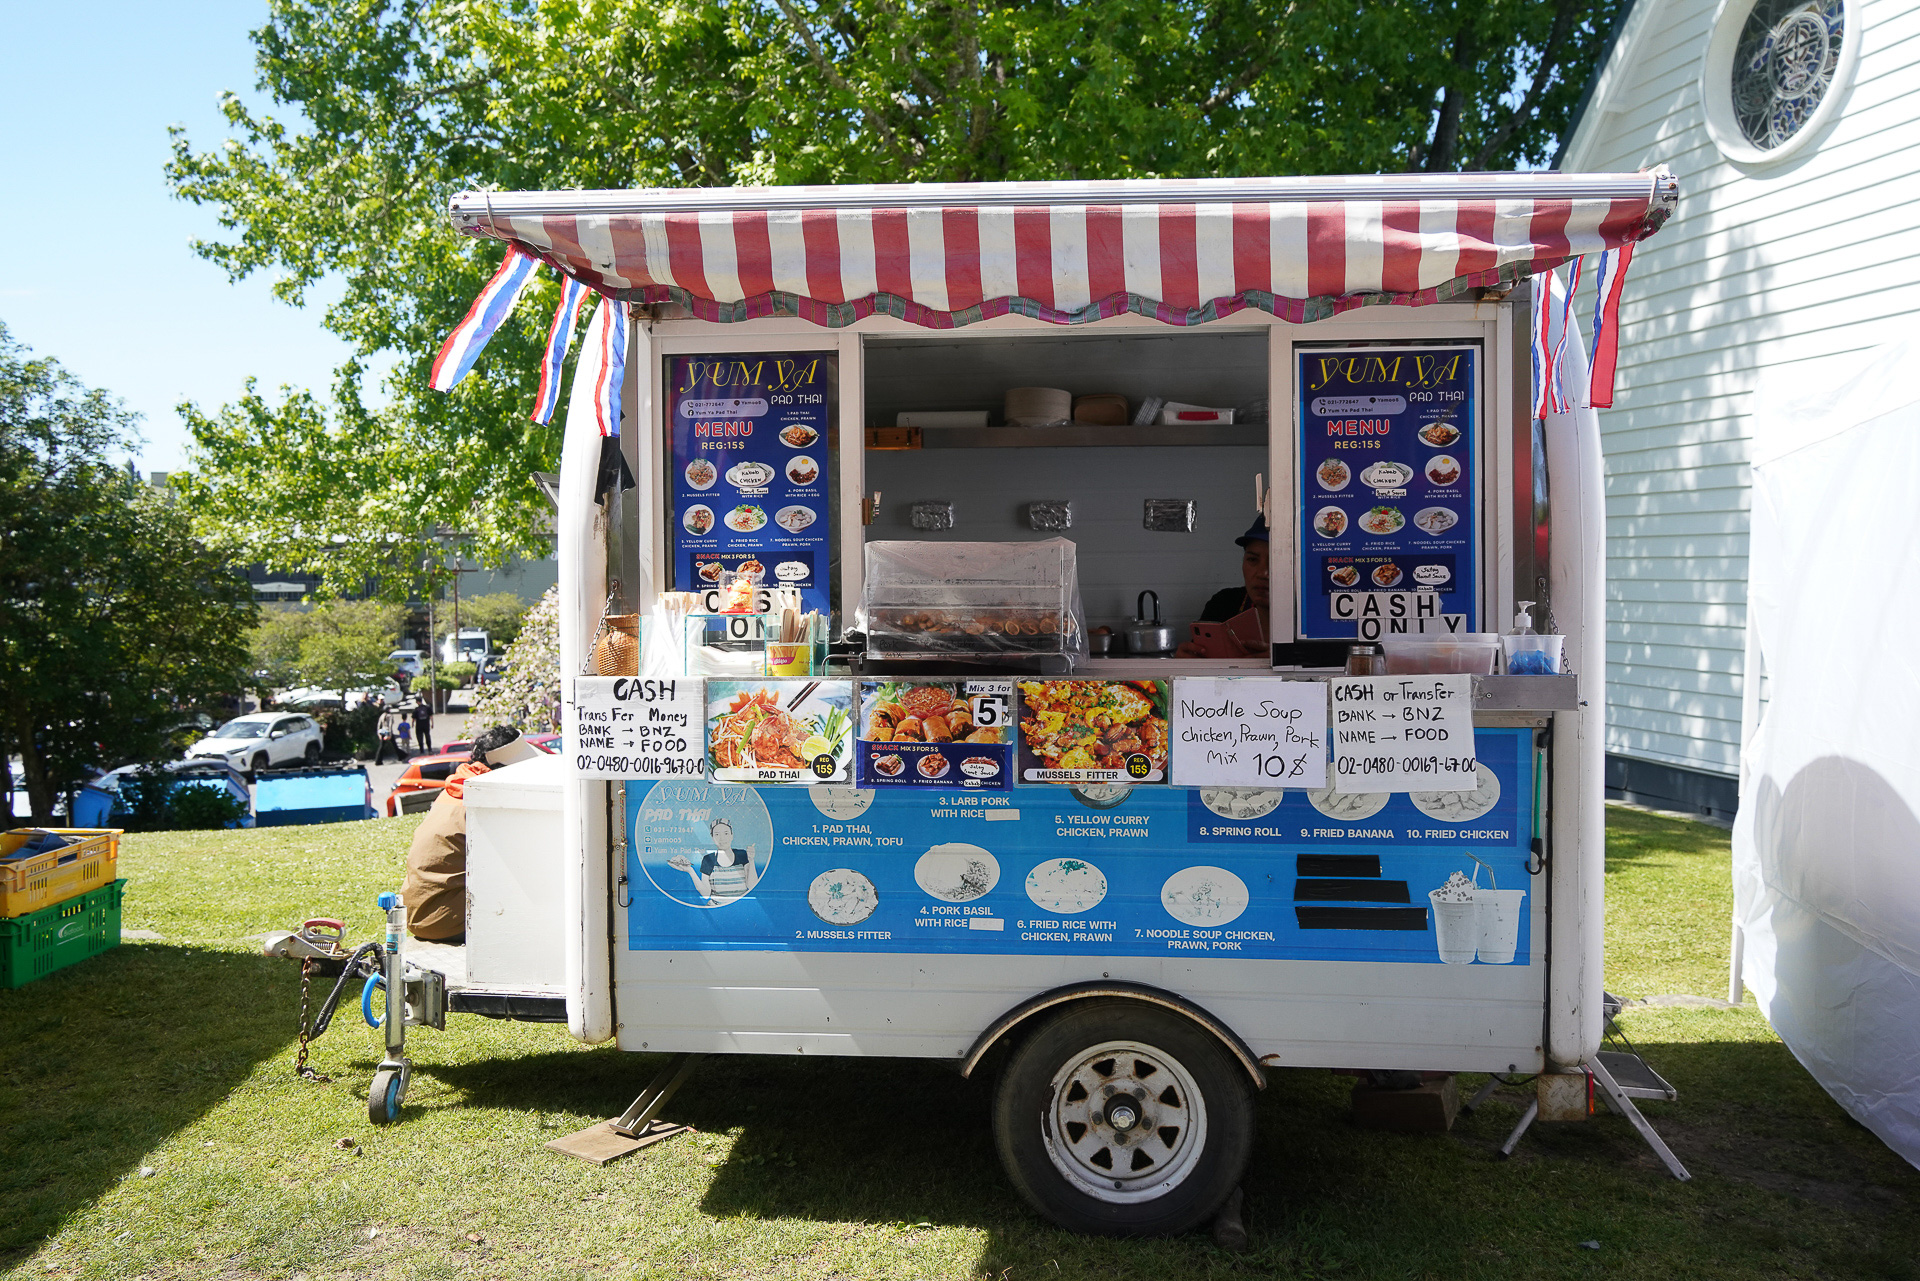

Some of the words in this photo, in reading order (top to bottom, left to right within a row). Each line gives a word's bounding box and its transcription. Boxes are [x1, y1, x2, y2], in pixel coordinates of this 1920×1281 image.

[680, 359, 766, 394] YUM
[768, 358, 820, 393] YA
[1310, 356, 1404, 390] YUM
[1406, 354, 1462, 390] YA
[771, 394, 793, 405] PAD
[798, 394, 822, 404] THAI
[1409, 391, 1433, 402] PAD
[1438, 390, 1464, 401] THAI
[695, 421, 753, 438] MENU
[1327, 419, 1390, 436] MENU
[702, 441, 745, 450] REG:15$
[1334, 440, 1381, 449] REG:15$
[1335, 594, 1434, 618] CASH
[614, 678, 676, 702] CASH
[1335, 683, 1374, 701] CASH
[1383, 691, 1398, 701] or
[978, 698, 997, 725] 5
[1181, 700, 1244, 718] Noodle
[1254, 700, 1302, 724] Soup
[1338, 709, 1376, 723] BANK
[1402, 707, 1444, 722] BNZ
[649, 708, 687, 727] Money
[579, 724, 611, 737] BANK
[640, 726, 676, 737] BNZ
[1339, 731, 1376, 744] NAME
[1405, 728, 1449, 742] FOOD
[1240, 724, 1278, 751] Prawn,
[1286, 726, 1319, 748] Pork
[580, 737, 615, 749] NAME
[641, 738, 687, 752] FOOD
[1207, 750, 1237, 765] Mix
[758, 770, 776, 779] PAD
[778, 770, 800, 779] THAI
[816, 763, 833, 776] 15$
[1037, 770, 1081, 780] MUSSELS
[1086, 770, 1118, 780] FITTER
[1130, 764, 1148, 775] 15$
[656, 787, 709, 804] YUM
[716, 786, 748, 806] YA
[939, 797, 948, 806] 3.
[951, 797, 978, 806] LARB
[980, 797, 1010, 806] PORK
[644, 808, 673, 822] PAD
[678, 808, 712, 822] THAI
[931, 809, 958, 818] WITH
[960, 809, 984, 818] RICE
[1055, 815, 1065, 824] 5.
[1067, 815, 1111, 824] YELLOW
[1113, 816, 1150, 825] CURRY
[812, 825, 820, 834] 1.
[823, 825, 843, 834] PAD
[845, 825, 872, 835] THAI,
[1056, 828, 1106, 838] CHICKEN,
[1109, 828, 1148, 838] PRAWN
[1199, 827, 1210, 836] 8.
[1212, 827, 1251, 836] SPRING
[1254, 828, 1282, 837] ROLL
[1300, 829, 1310, 838] 9.
[1313, 829, 1345, 838] FRIED
[1348, 829, 1394, 838] BANANA
[1407, 829, 1422, 838] 10.
[1425, 830, 1457, 839] FRIED
[1460, 830, 1509, 839] CHICKEN
[782, 837, 830, 847] CHICKEN,
[832, 837, 873, 847] PRAWN,
[876, 837, 903, 846] TOFU
[920, 906, 930, 915] 4.
[932, 906, 961, 915] PORK
[963, 906, 993, 915] BASIL
[915, 918, 942, 927] WITH
[944, 919, 968, 927] RICE
[1017, 920, 1027, 929] 6.
[1029, 920, 1060, 929] FRIED
[1062, 921, 1087, 930] RICE
[1089, 921, 1117, 930] WITH
[796, 931, 805, 939] 2.
[807, 931, 854, 940] MUSSELS
[857, 931, 891, 940] FITTER
[1021, 932, 1072, 942] CHICKEN,
[1074, 933, 1112, 942] PRAWN
[1135, 929, 1144, 938] 7.
[1146, 930, 1191, 939] NOODLE
[1193, 930, 1222, 939] SOUP
[1225, 931, 1276, 942] CHICKEN,
[1167, 941, 1210, 951] PRAWN,
[1212, 941, 1242, 950] PORK
